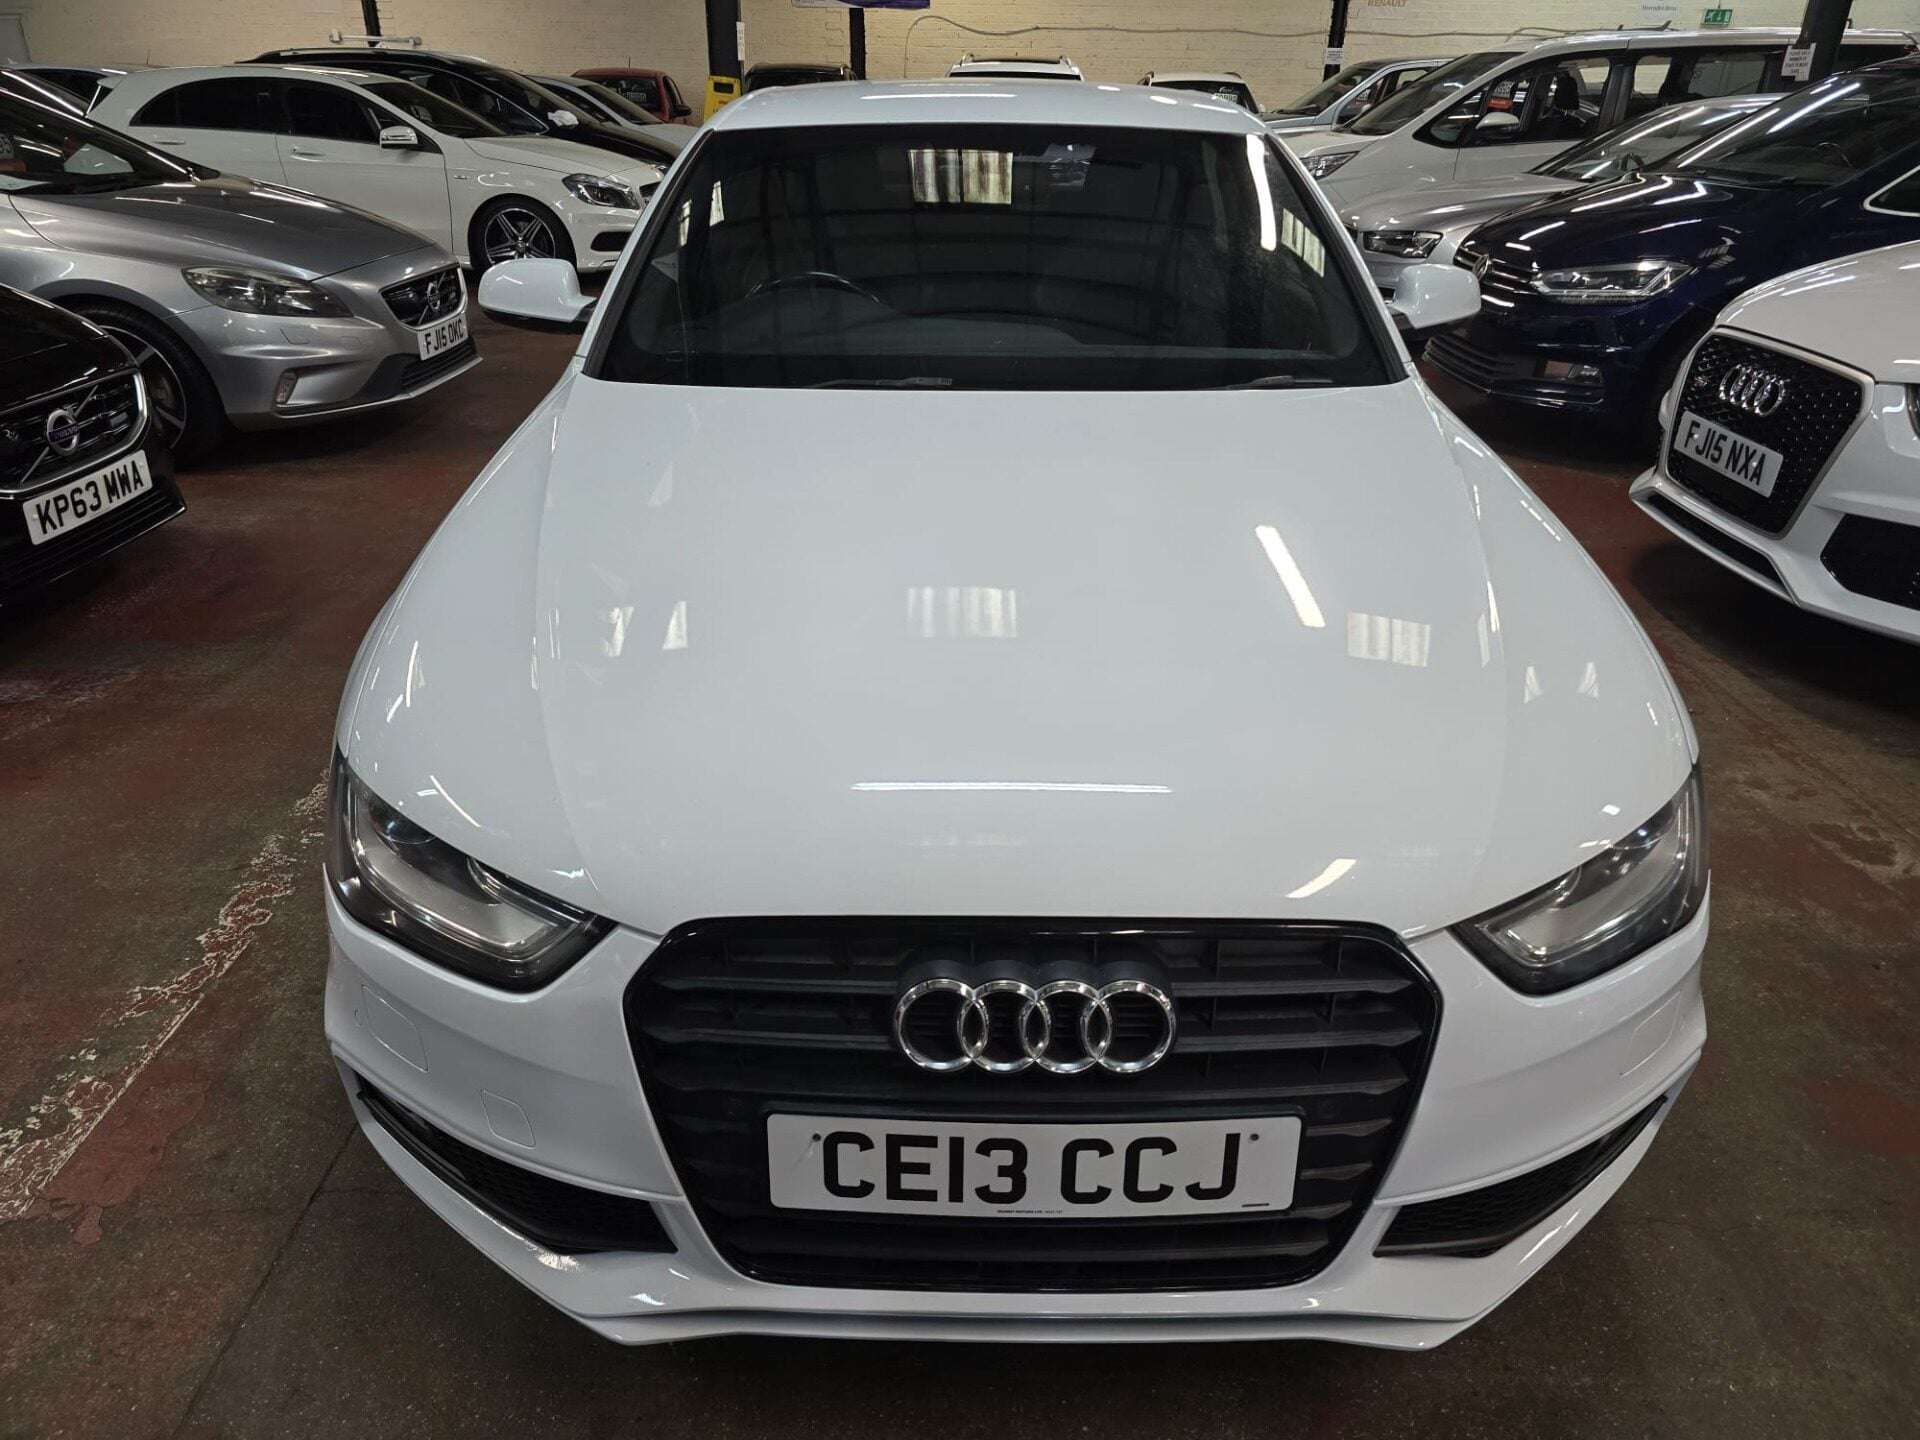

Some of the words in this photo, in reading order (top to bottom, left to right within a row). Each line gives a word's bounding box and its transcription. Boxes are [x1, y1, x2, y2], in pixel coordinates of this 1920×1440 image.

[424, 326, 448, 355] FJ15
[447, 318, 465, 344] OKC
[1684, 419, 1728, 465] FJ15
[1726, 439, 1767, 486] NXA
[36, 480, 102, 535] KP63
[103, 460, 144, 504] MWA
[822, 1130, 1029, 1205] CE13
[1060, 1132, 1241, 1205] CCJ
